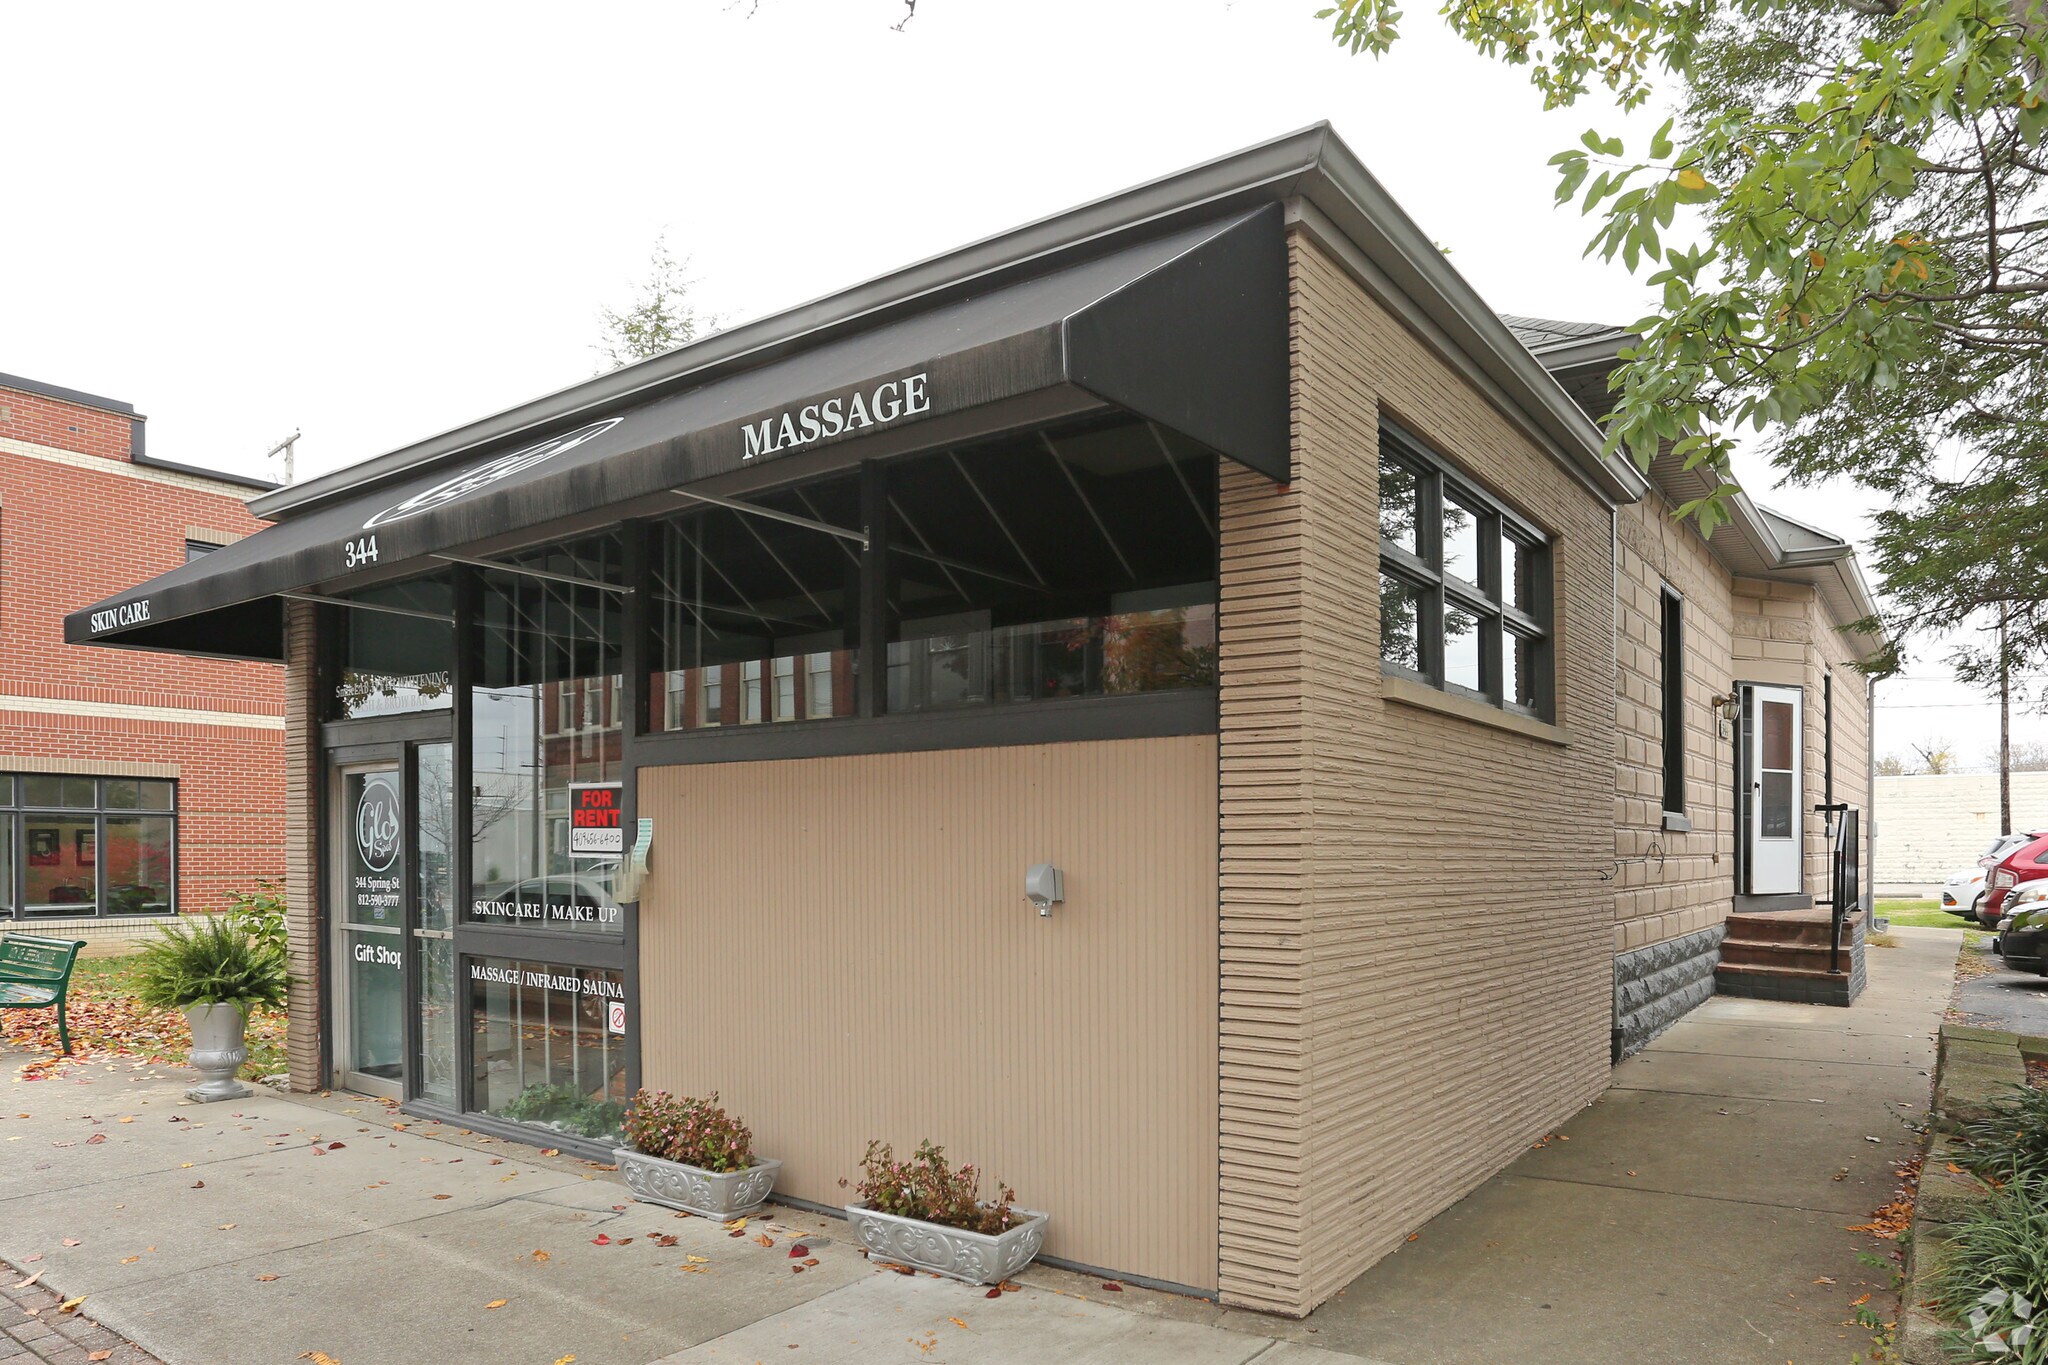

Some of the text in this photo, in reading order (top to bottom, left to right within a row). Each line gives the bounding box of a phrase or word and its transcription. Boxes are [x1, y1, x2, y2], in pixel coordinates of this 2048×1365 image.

[741, 373, 930, 460] MASSAGE
[345, 534, 379, 568] 344
[91, 600, 150, 633] SKIN CARE
[397, 671, 450, 689] WHITENING
[385, 695, 409, 710] BROW
[411, 693, 428, 707] BAR
[581, 789, 613, 808] FOR
[573, 808, 620, 828] RENT
[355, 876, 367, 888] 344
[368, 876, 391, 892] Spring
[357, 894, 400, 907] 812-590-3777
[475, 900, 617, 923] SKINCARE / MAKE UP
[355, 943, 375, 963] Gift
[471, 965, 625, 998] MASSAGE / INFRARED SAUNA
